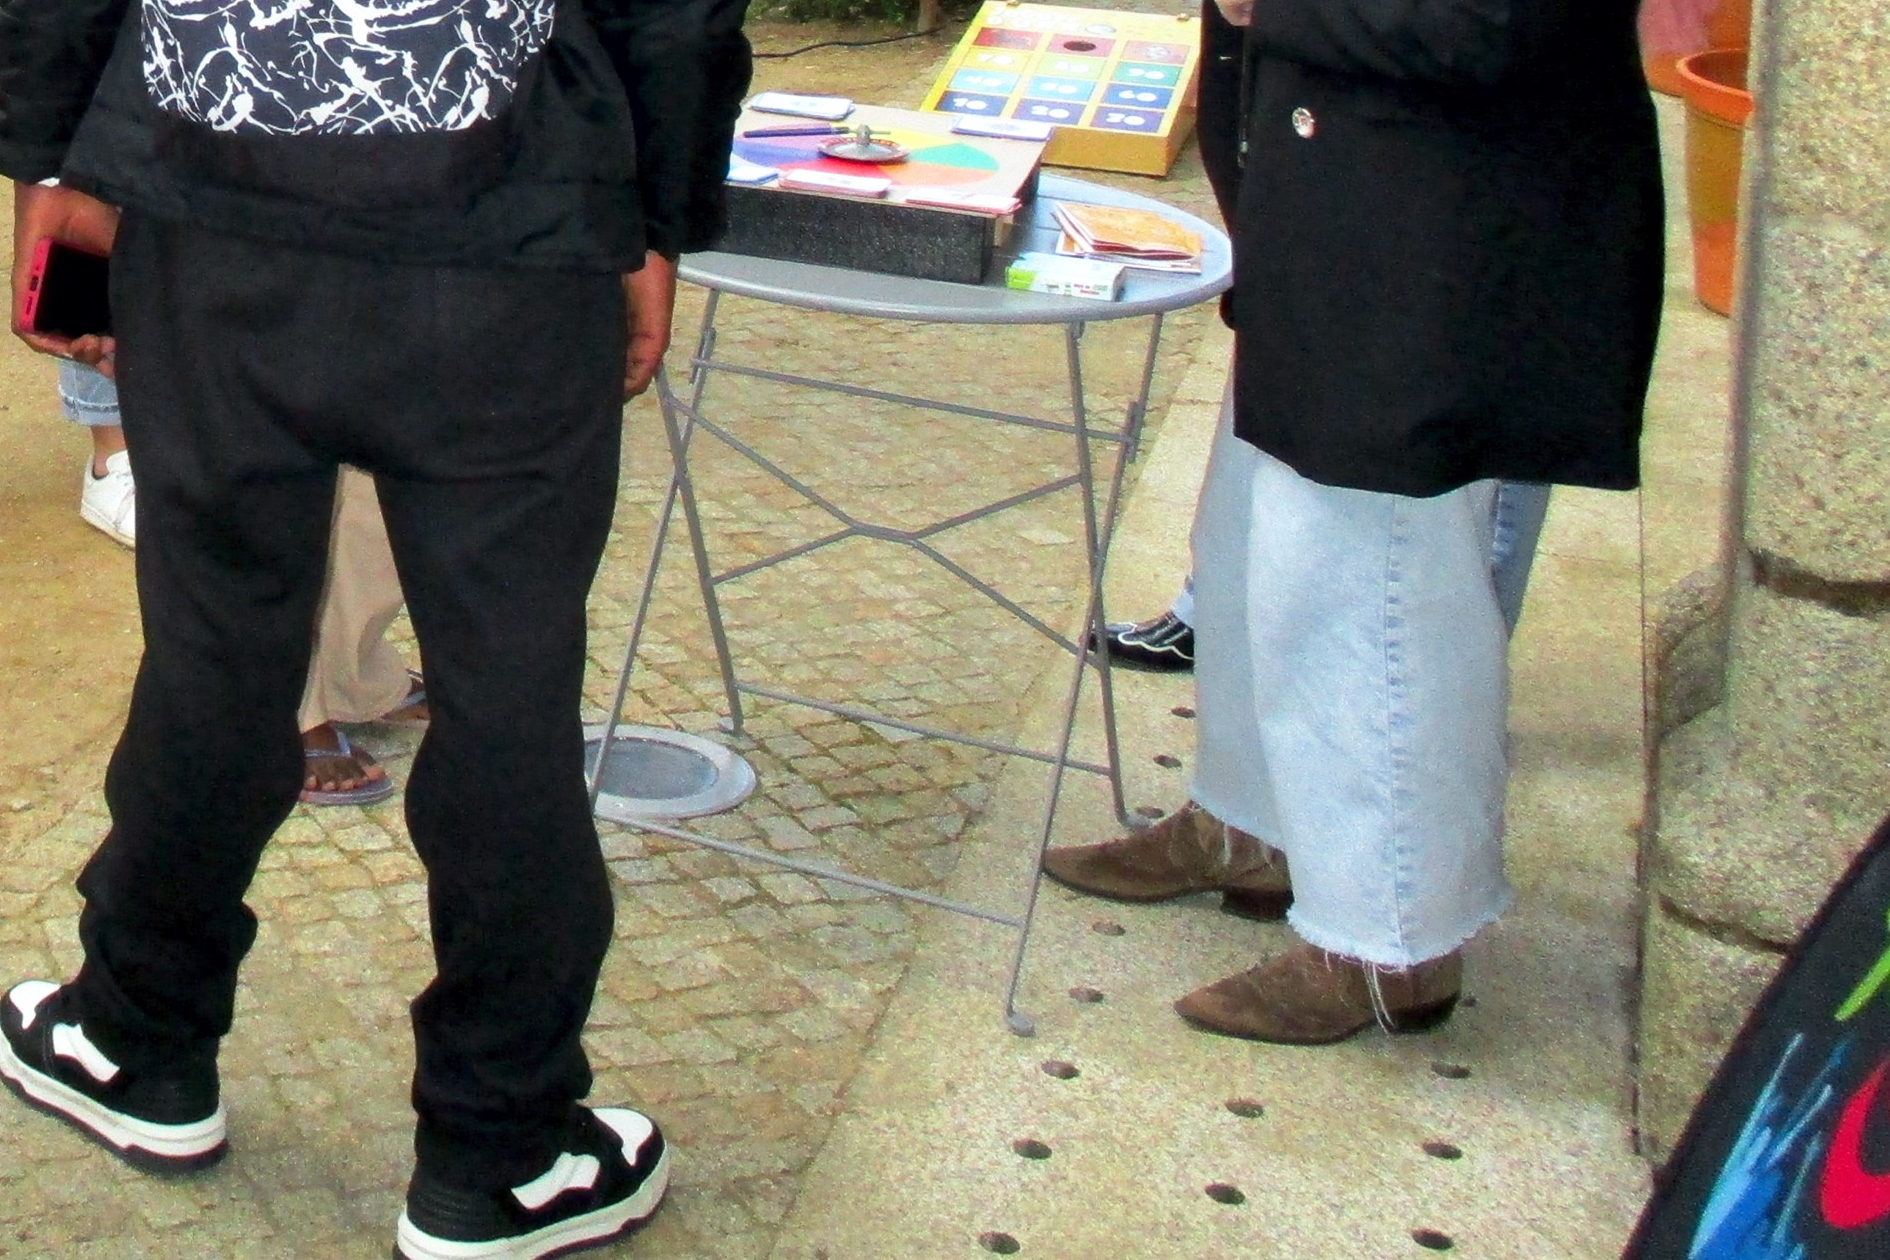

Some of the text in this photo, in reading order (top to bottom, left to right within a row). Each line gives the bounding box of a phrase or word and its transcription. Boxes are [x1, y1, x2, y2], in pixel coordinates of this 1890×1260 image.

[953, 97, 1145, 126] 10 20 30
